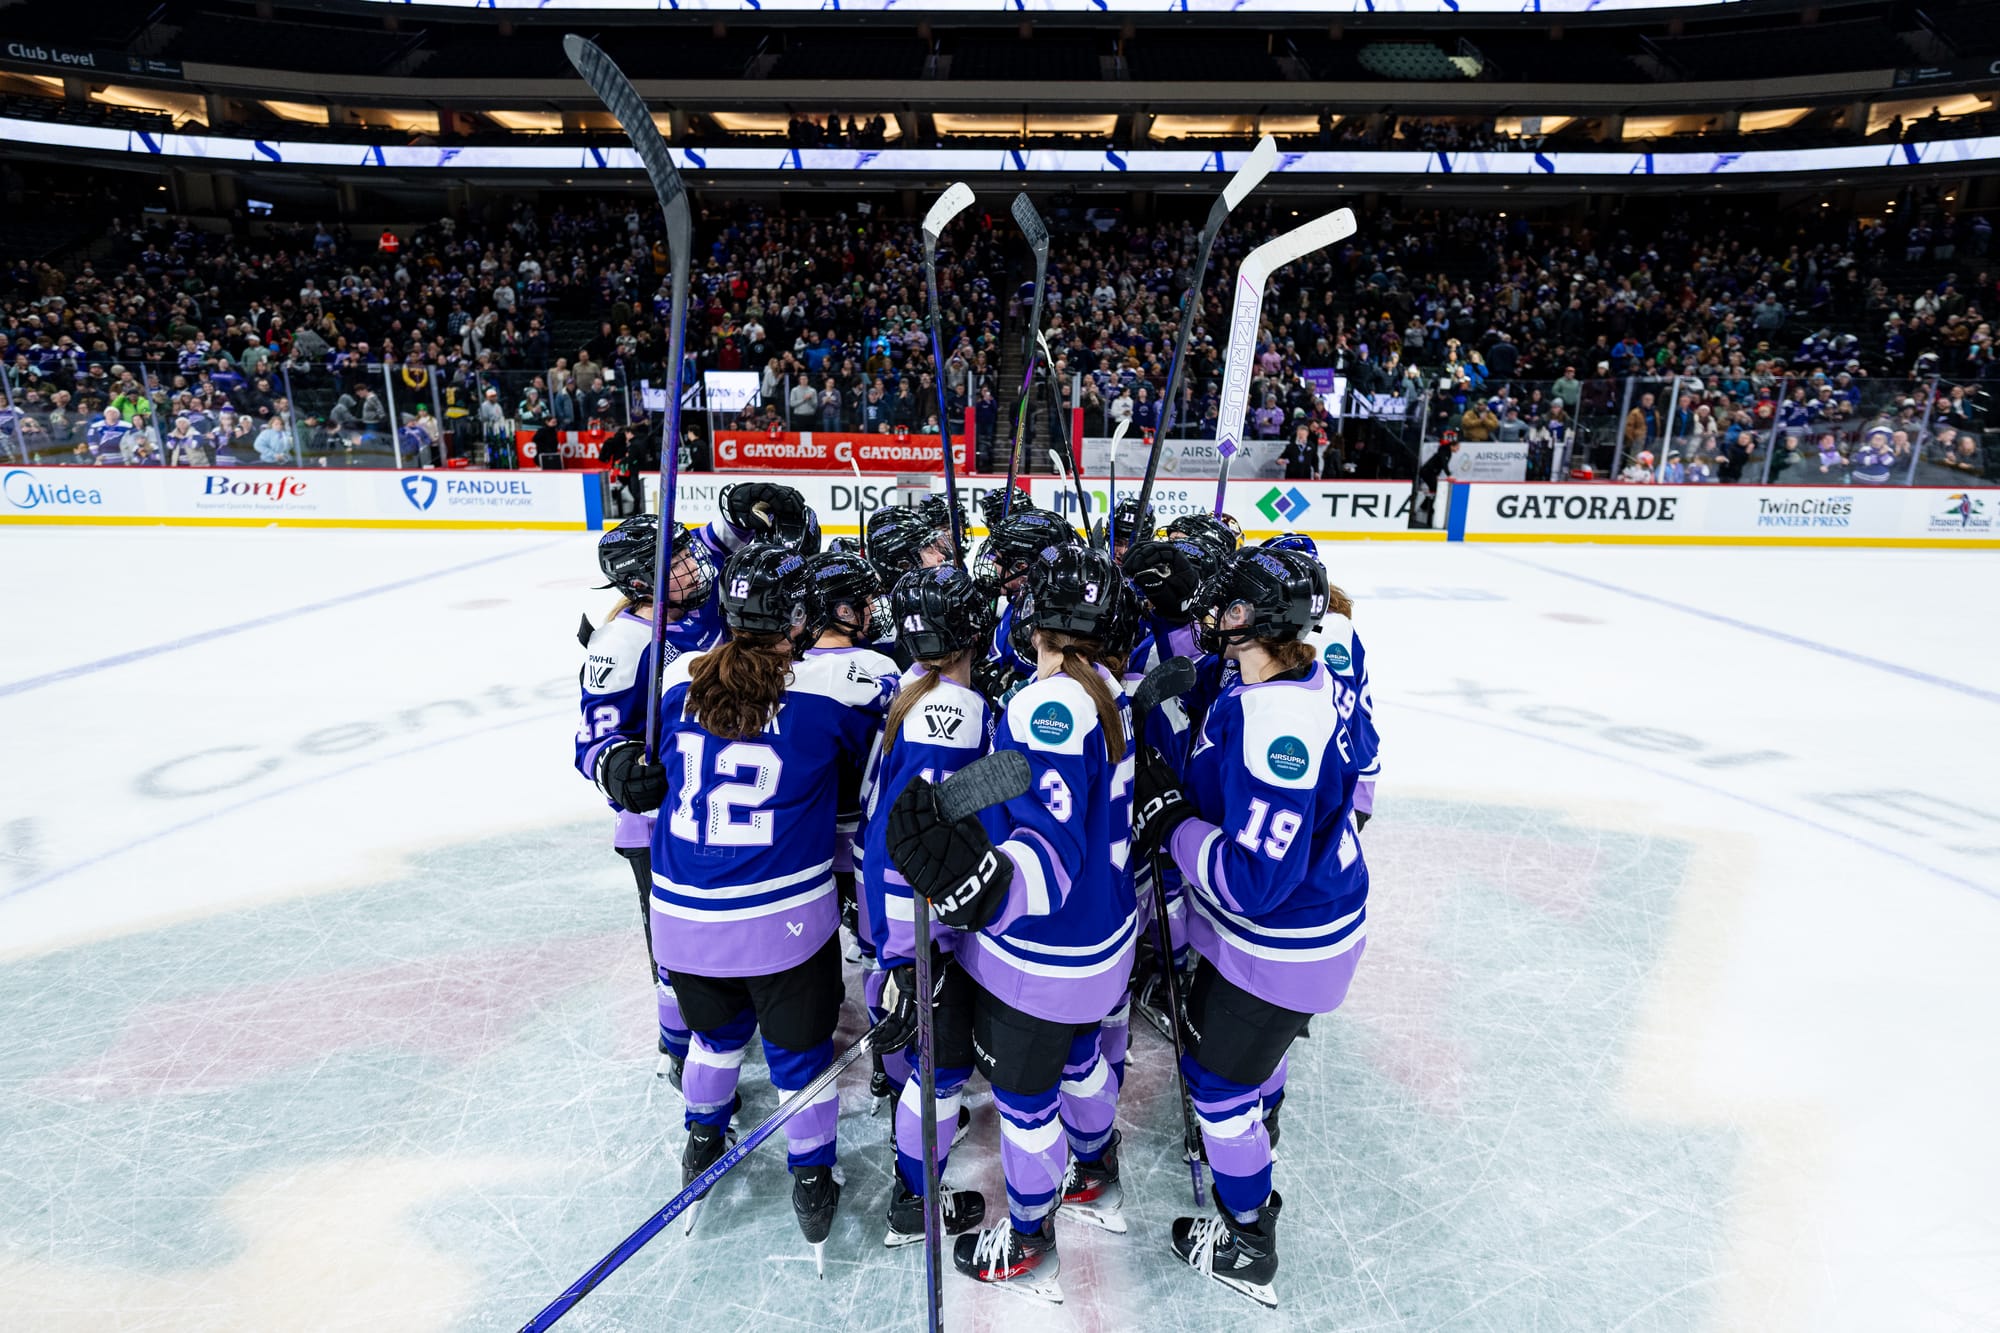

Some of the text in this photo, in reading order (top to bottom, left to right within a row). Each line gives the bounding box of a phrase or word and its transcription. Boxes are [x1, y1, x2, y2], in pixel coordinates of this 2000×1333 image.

[8, 43, 96, 67] Club Level
[718, 439, 737, 461] G
[743, 443, 827, 458] GATORADE
[834, 442, 852, 462] G
[859, 445, 943, 460] GATORADE
[24, 483, 102, 505] Midea
[203, 475, 307, 500] Bonfe
[446, 480, 532, 494] FANDUEL
[449, 497, 532, 507] SPORTS NETWORK
[1496, 495, 1678, 521] GATORADE
[1759, 498, 1852, 514] TwinCities
[1124, 512, 1135, 523] 11
[1758, 516, 1849, 526] PIONEER PRESS
[1251, 552, 1291, 582] FROST
[729, 578, 750, 600] 12
[1084, 584, 1099, 604] 3
[1310, 594, 1324, 614] 19
[903, 613, 925, 633] 41
[589, 654, 616, 666] PWHL
[924, 704, 966, 718] PWHL
[1032, 718, 1070, 731] AIRSUPRA
[1269, 752, 1306, 766] AIRSUPRA
[669, 731, 784, 846] 12
[1039, 768, 1073, 824] 3
[1236, 797, 1303, 862] 19
[934, 850, 998, 917] CCM
